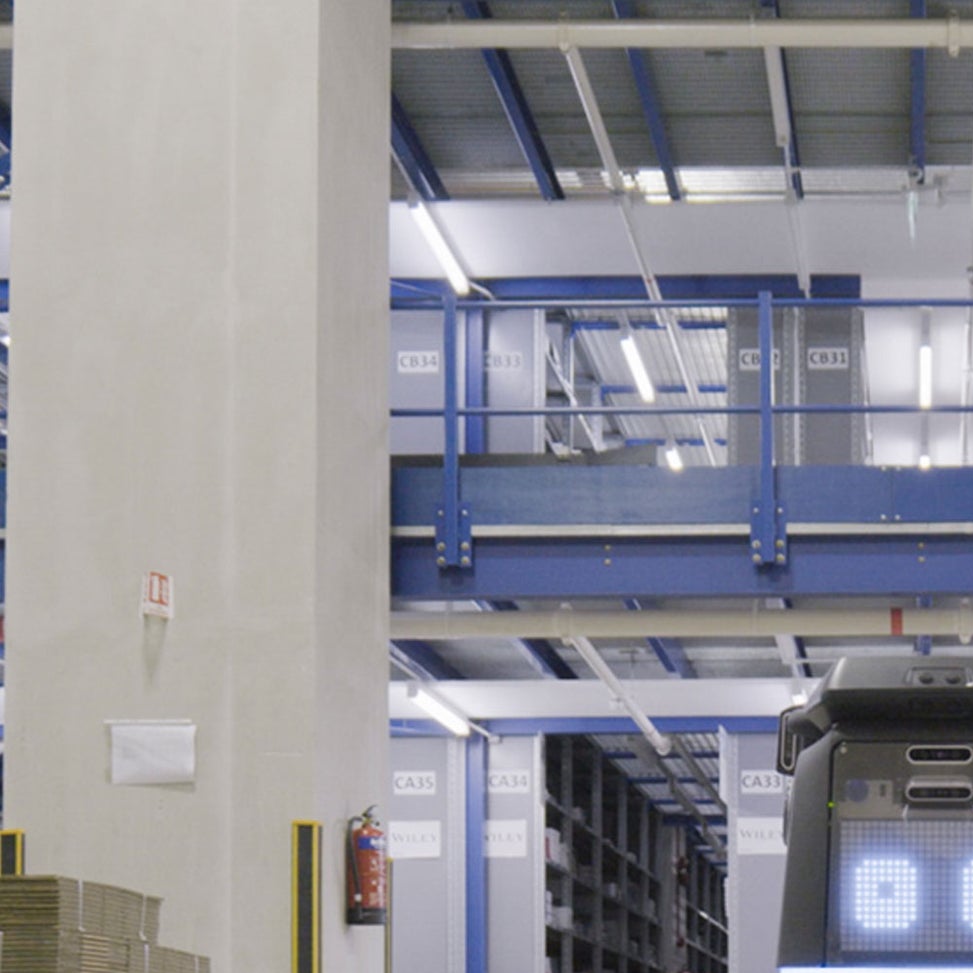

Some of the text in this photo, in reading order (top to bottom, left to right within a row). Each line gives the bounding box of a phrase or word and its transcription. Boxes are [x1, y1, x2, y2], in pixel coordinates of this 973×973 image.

[399, 354, 438, 368] CB34
[741, 351, 779, 366] CB2
[808, 351, 847, 365] CB31
[394, 775, 434, 789] CA35
[488, 774, 527, 788] CA34
[743, 774, 781, 788] CA33
